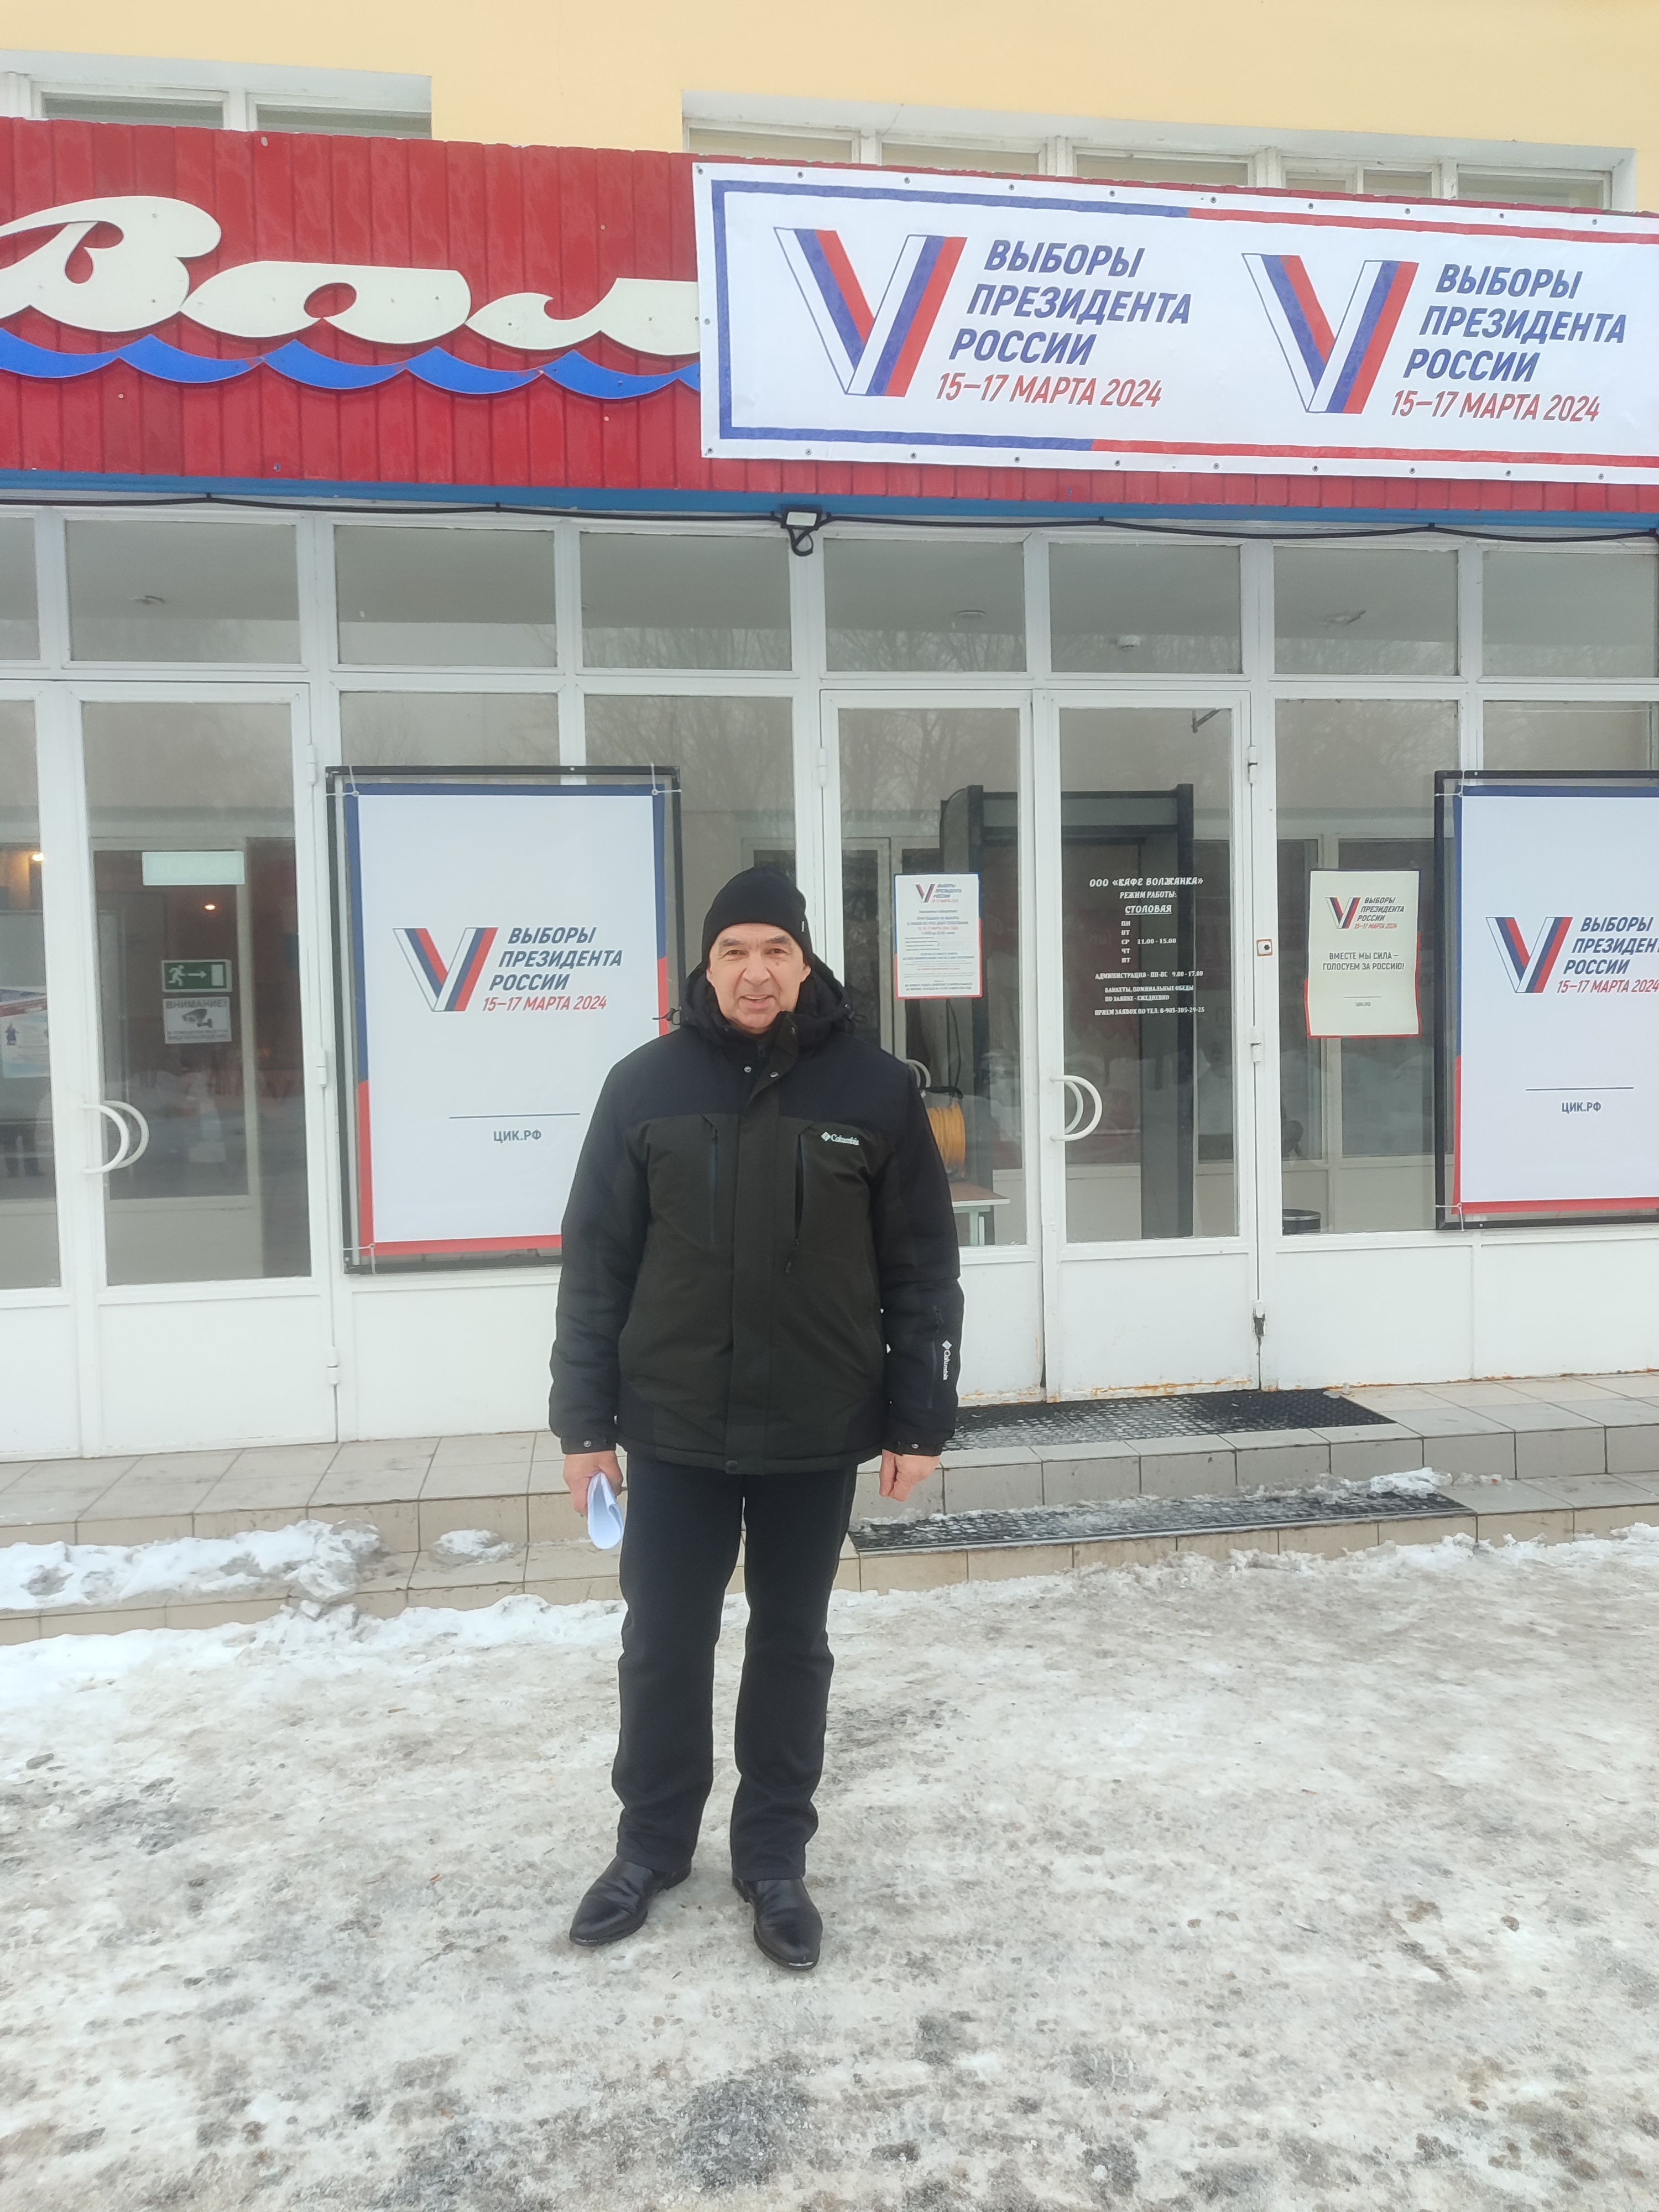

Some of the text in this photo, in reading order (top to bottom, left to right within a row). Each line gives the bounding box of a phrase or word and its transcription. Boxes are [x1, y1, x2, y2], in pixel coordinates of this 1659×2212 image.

[984, 239, 1145, 277] ВЫБОРЫ
[1436, 264, 1582, 299] ВЫБОРЫ
[966, 284, 1192, 325] ПРЕЗИДЕНТА
[1419, 306, 1627, 344] ПРЕЗИДЕНТА
[949, 328, 1097, 365] РОССИИ
[1404, 349, 1540, 382] РОССИИ
[1010, 375, 1097, 406] МАРТА
[1100, 379, 1162, 408] 2024
[1460, 392, 1541, 421] МАРТА
[1543, 395, 1600, 422] 2024
[1089, 877, 1204, 887] ООО «КАФЕ ВОЛЖАНКА»
[1125, 905, 1172, 914] СТОЛОВАЯ
[1580, 916, 1653, 932] ВЫБОРЫ
[508, 926, 597, 945] ВЫБОРЫ
[1572, 938, 1659, 955] ПРЕЗИДЕН
[498, 950, 623, 969] ПРЕЗИДЕНТА
[1563, 959, 1631, 975] РОССИИ
[489, 974, 570, 992] РОССИИ
[1590, 979, 1630, 993] МАРТА
[1631, 979, 1659, 993] 2024
[524, 995, 571, 1011] МАРТА
[573, 995, 607, 1011] 2024
[1561, 1102, 1601, 1114] ЦИК.РФ
[493, 1129, 542, 1143] ЦИК.РФ
